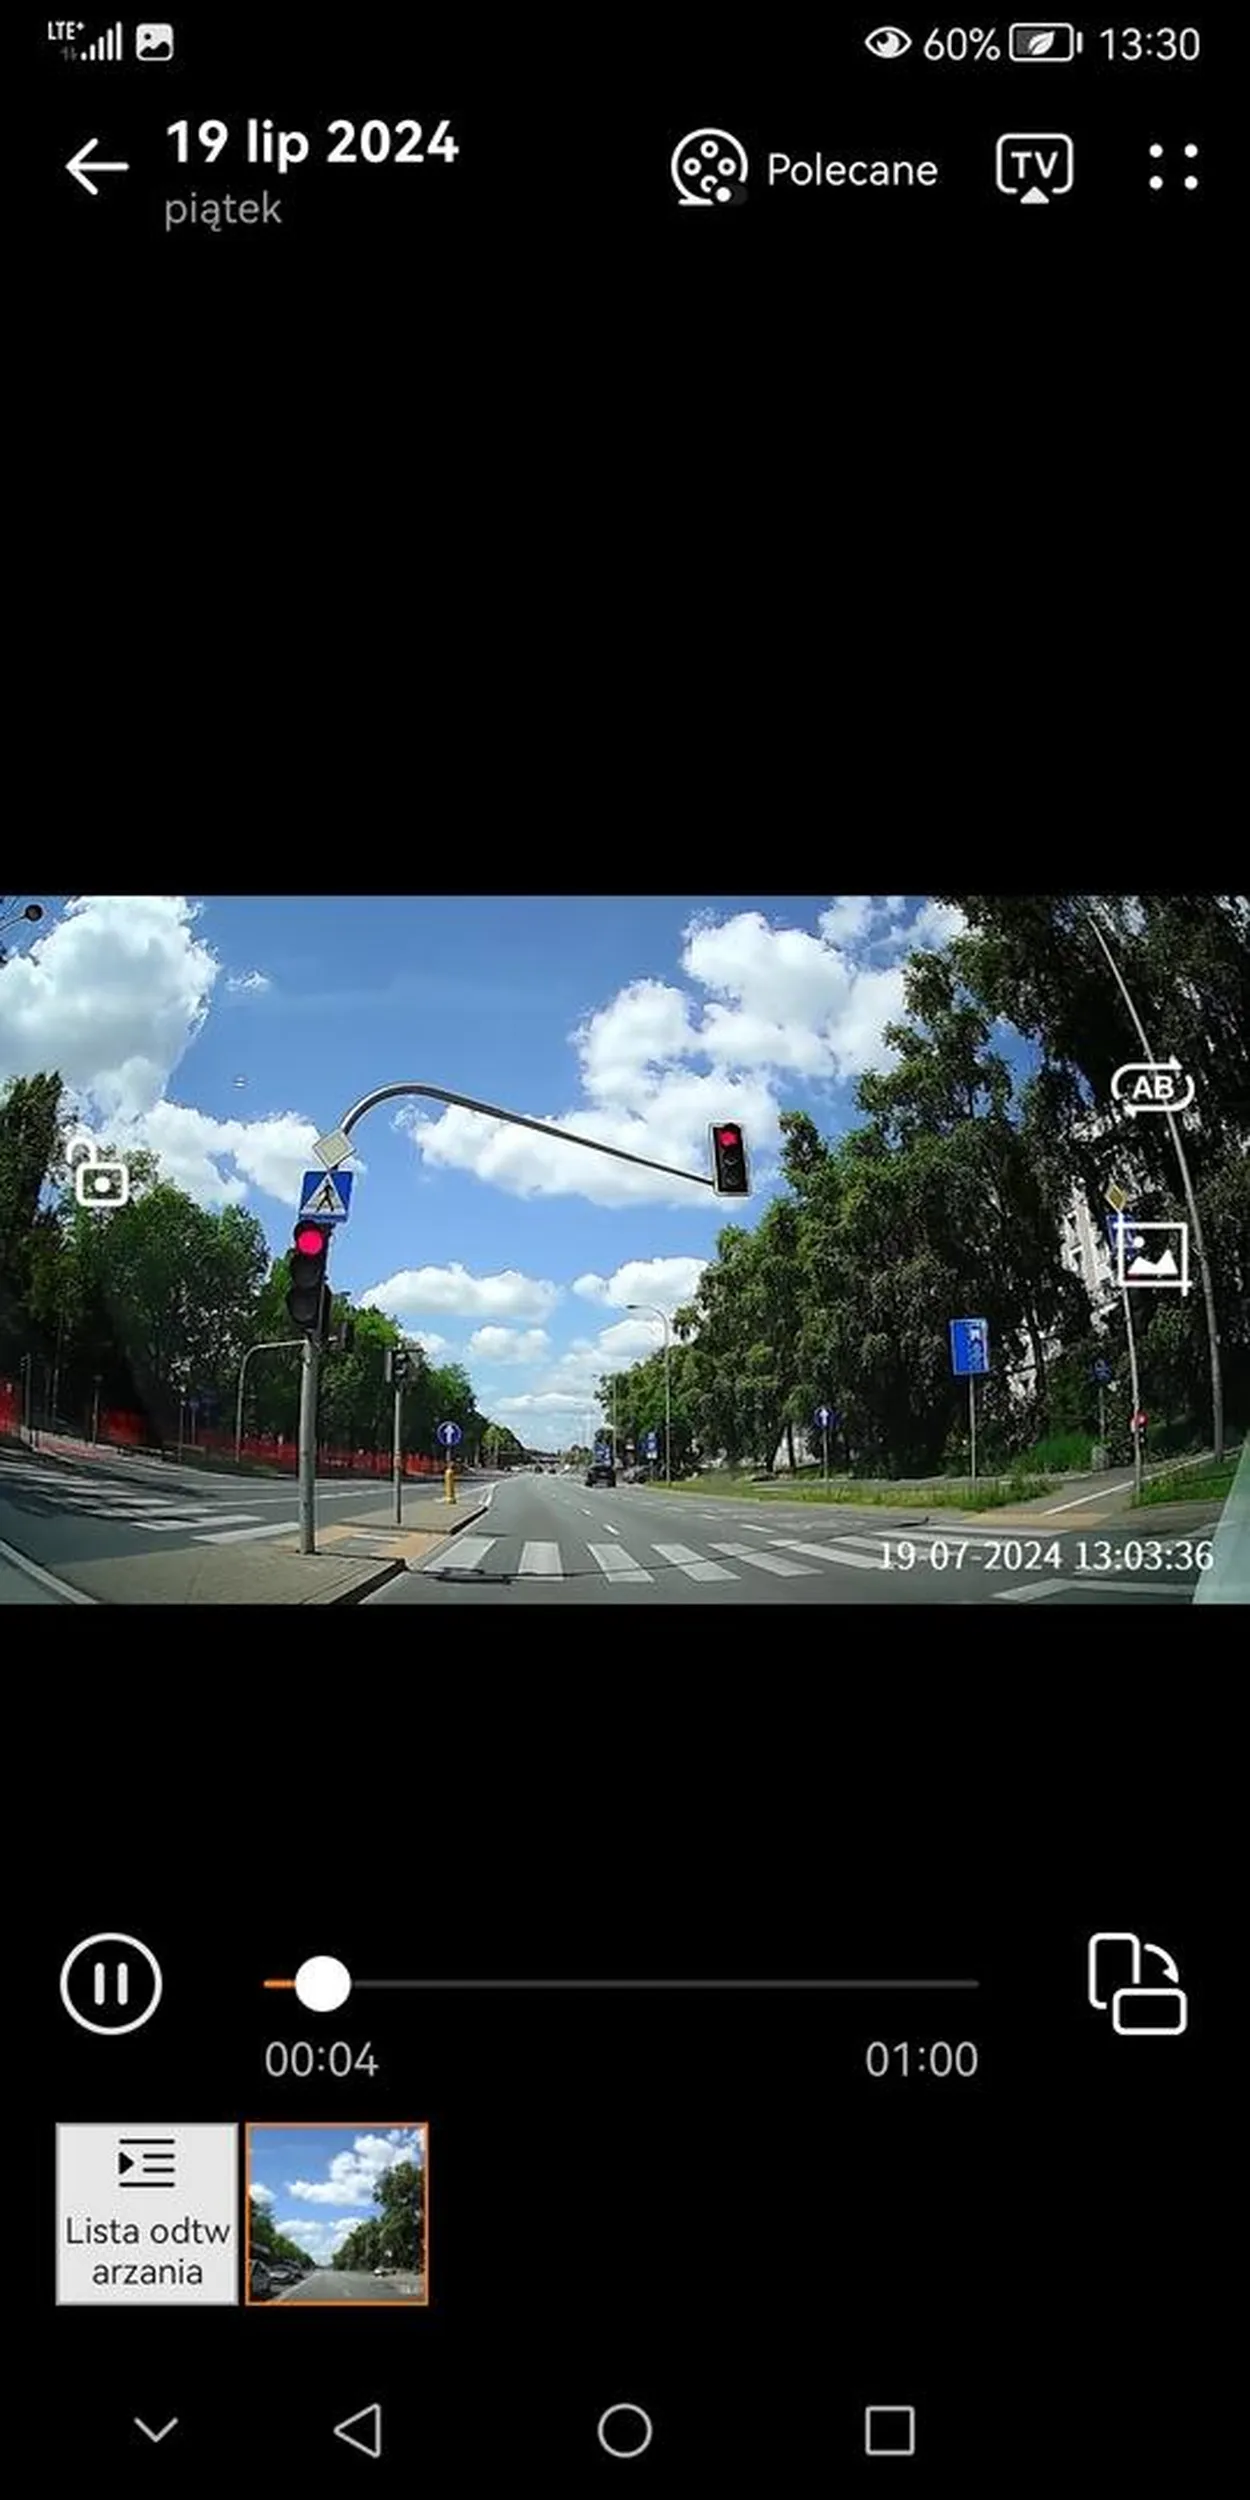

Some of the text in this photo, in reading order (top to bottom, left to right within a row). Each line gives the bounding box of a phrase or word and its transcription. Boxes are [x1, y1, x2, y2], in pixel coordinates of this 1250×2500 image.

[923, 26, 1001, 61] 60%
[1099, 26, 1201, 61] 13:30
[166, 118, 460, 175] 19 lip 2024
[768, 151, 939, 187] Polecane
[1011, 150, 1059, 180] TV
[165, 190, 282, 232] piątek
[1132, 1076, 1173, 1101] AB
[265, 2041, 379, 2078] 00:04
[866, 2041, 978, 2078] 01:00
[66, 2216, 230, 2245] Lista odtw
[92, 2258, 203, 2285] arzania
